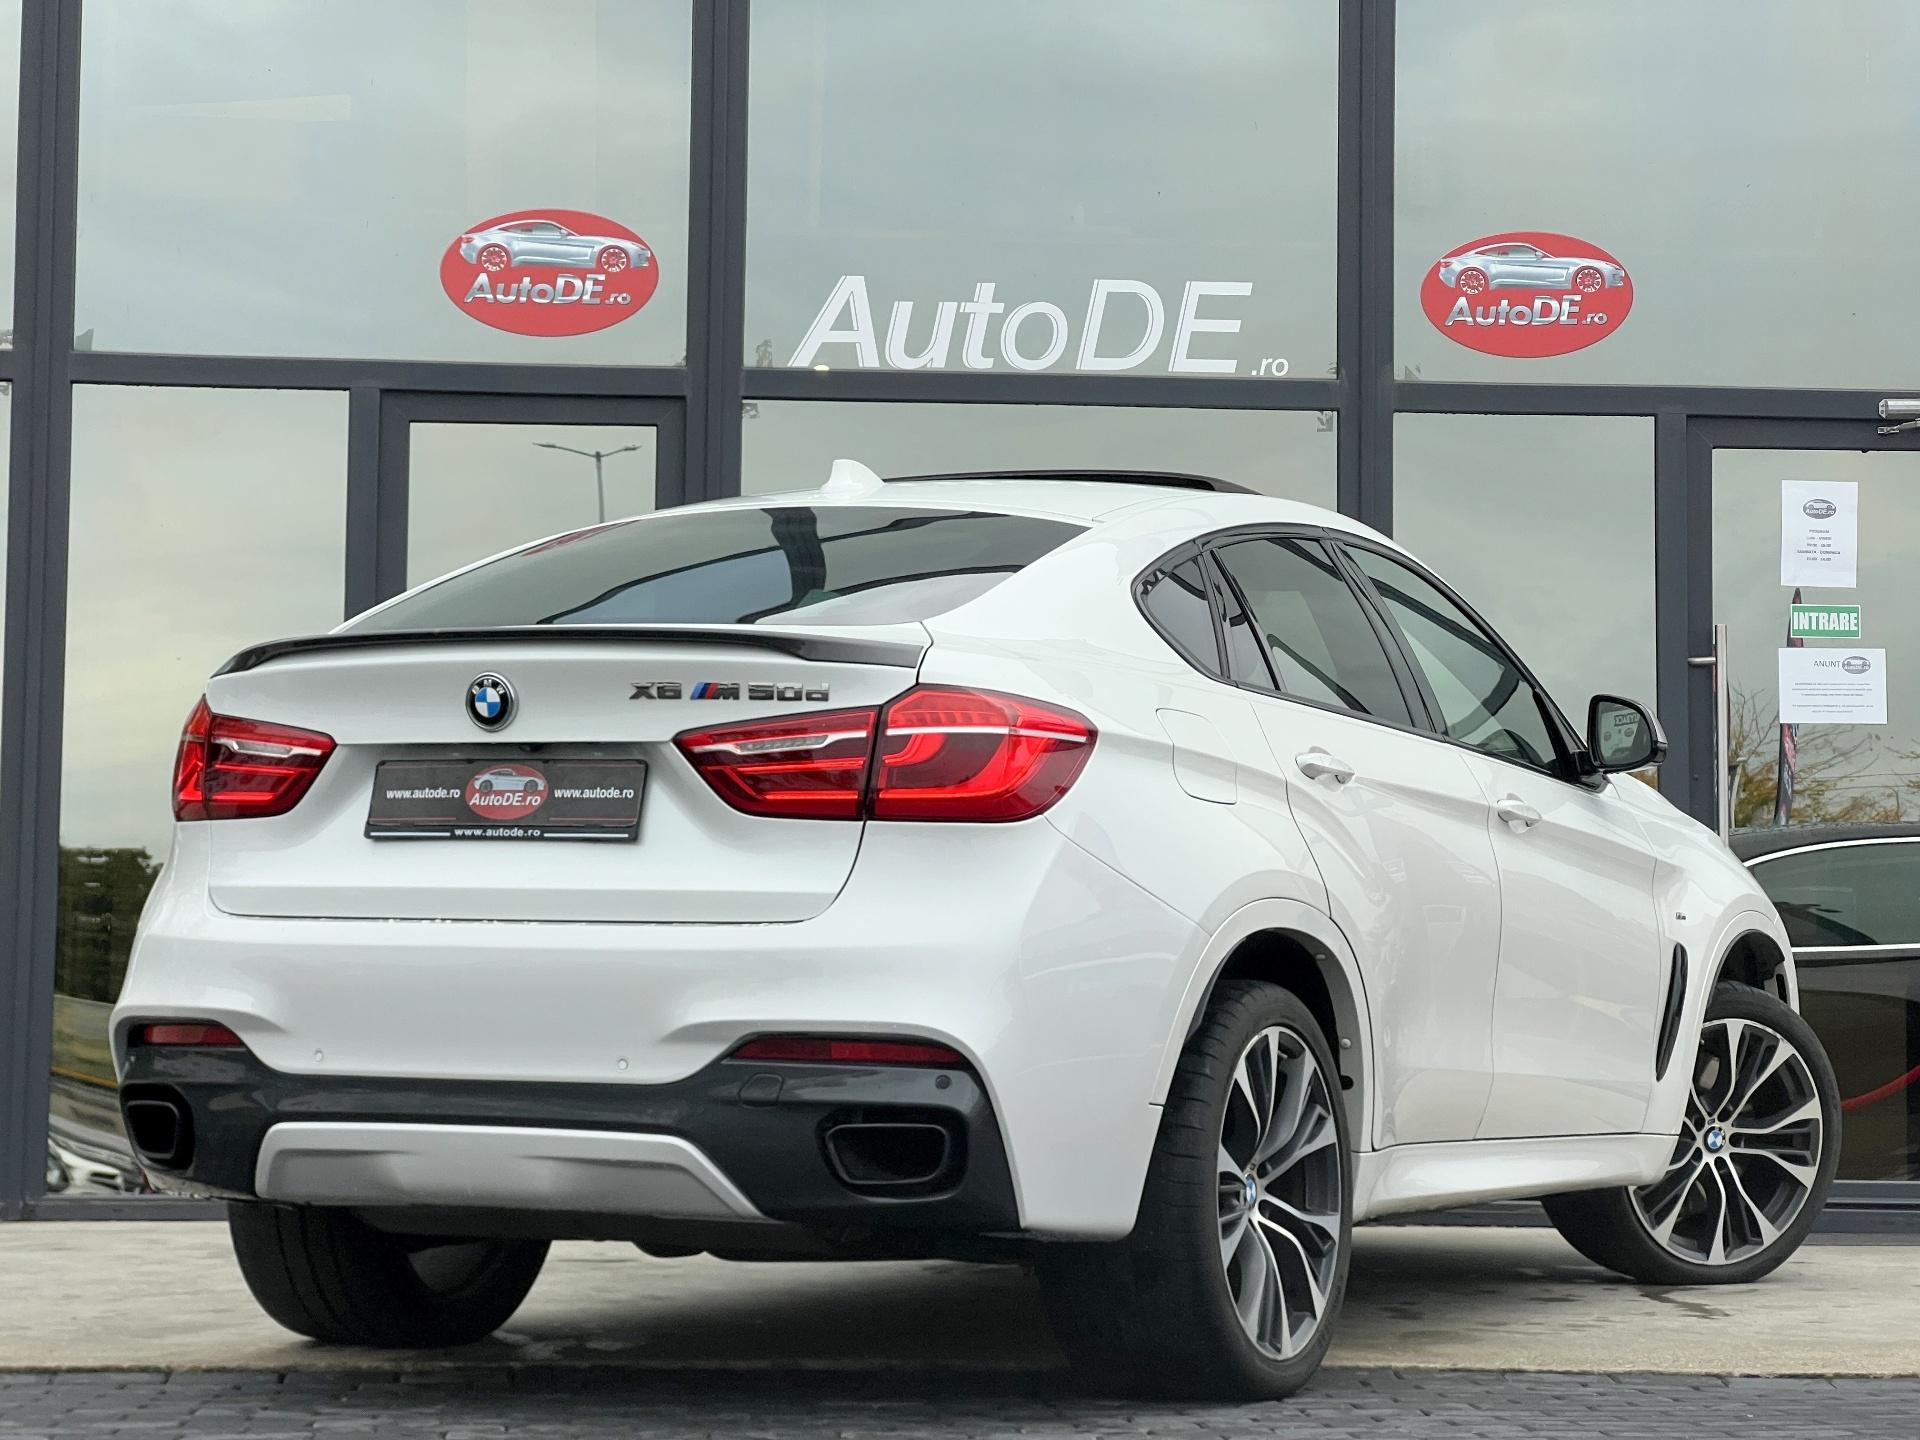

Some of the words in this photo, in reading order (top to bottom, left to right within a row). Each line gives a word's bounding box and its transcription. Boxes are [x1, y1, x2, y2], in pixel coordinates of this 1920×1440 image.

[1793, 611, 1858, 631] INTRARE
[1813, 660, 1840, 669] ANUNT
[629, 682, 682, 701] X6
[748, 682, 830, 702] 50d
[386, 787, 461, 800] www.autode.ro
[469, 791, 542, 807] AutoDE.ro
[554, 786, 635, 799] www.autode.ro
[454, 827, 542, 838] www.autode.ro
